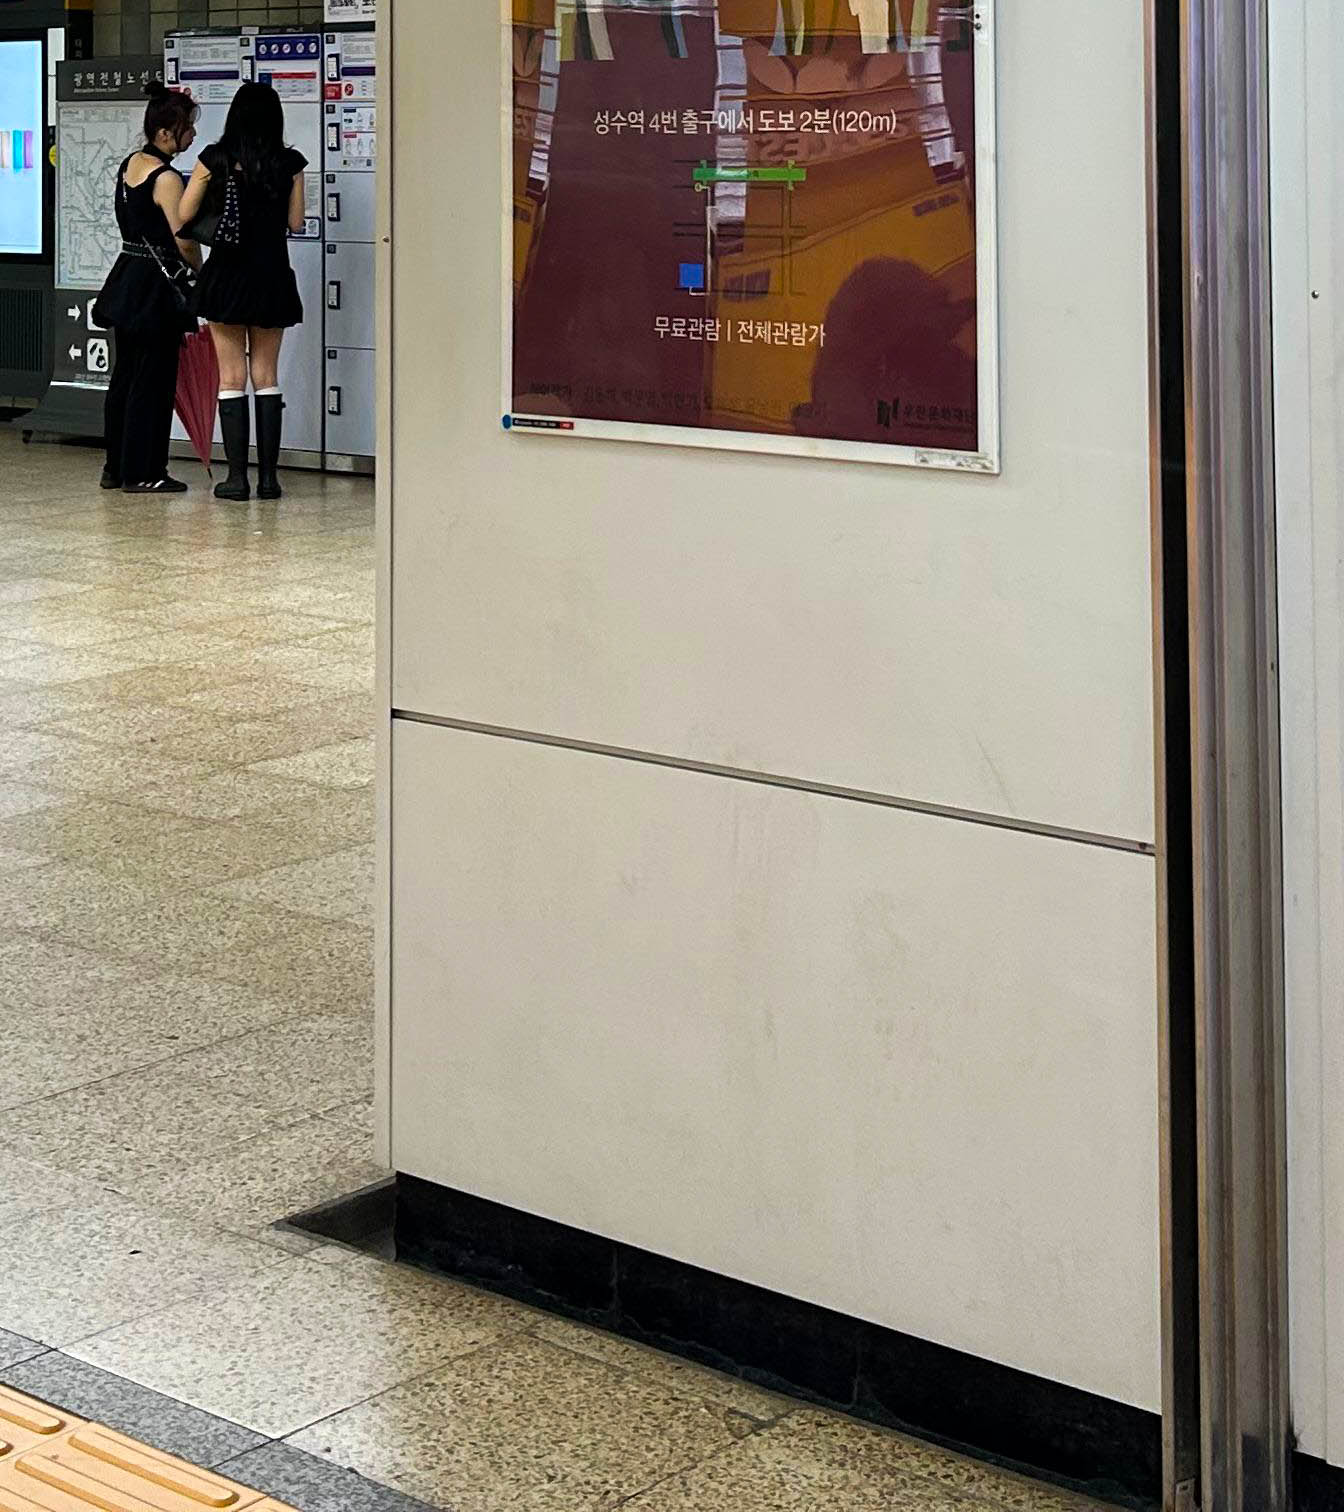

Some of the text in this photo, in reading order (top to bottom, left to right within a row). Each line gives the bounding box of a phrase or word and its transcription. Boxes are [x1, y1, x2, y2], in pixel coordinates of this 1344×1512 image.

[592, 108, 897, 135] 성수역 4번 출구에서 도보 2분(120m)
[654, 316, 827, 347] 무료관람 전체관람가
